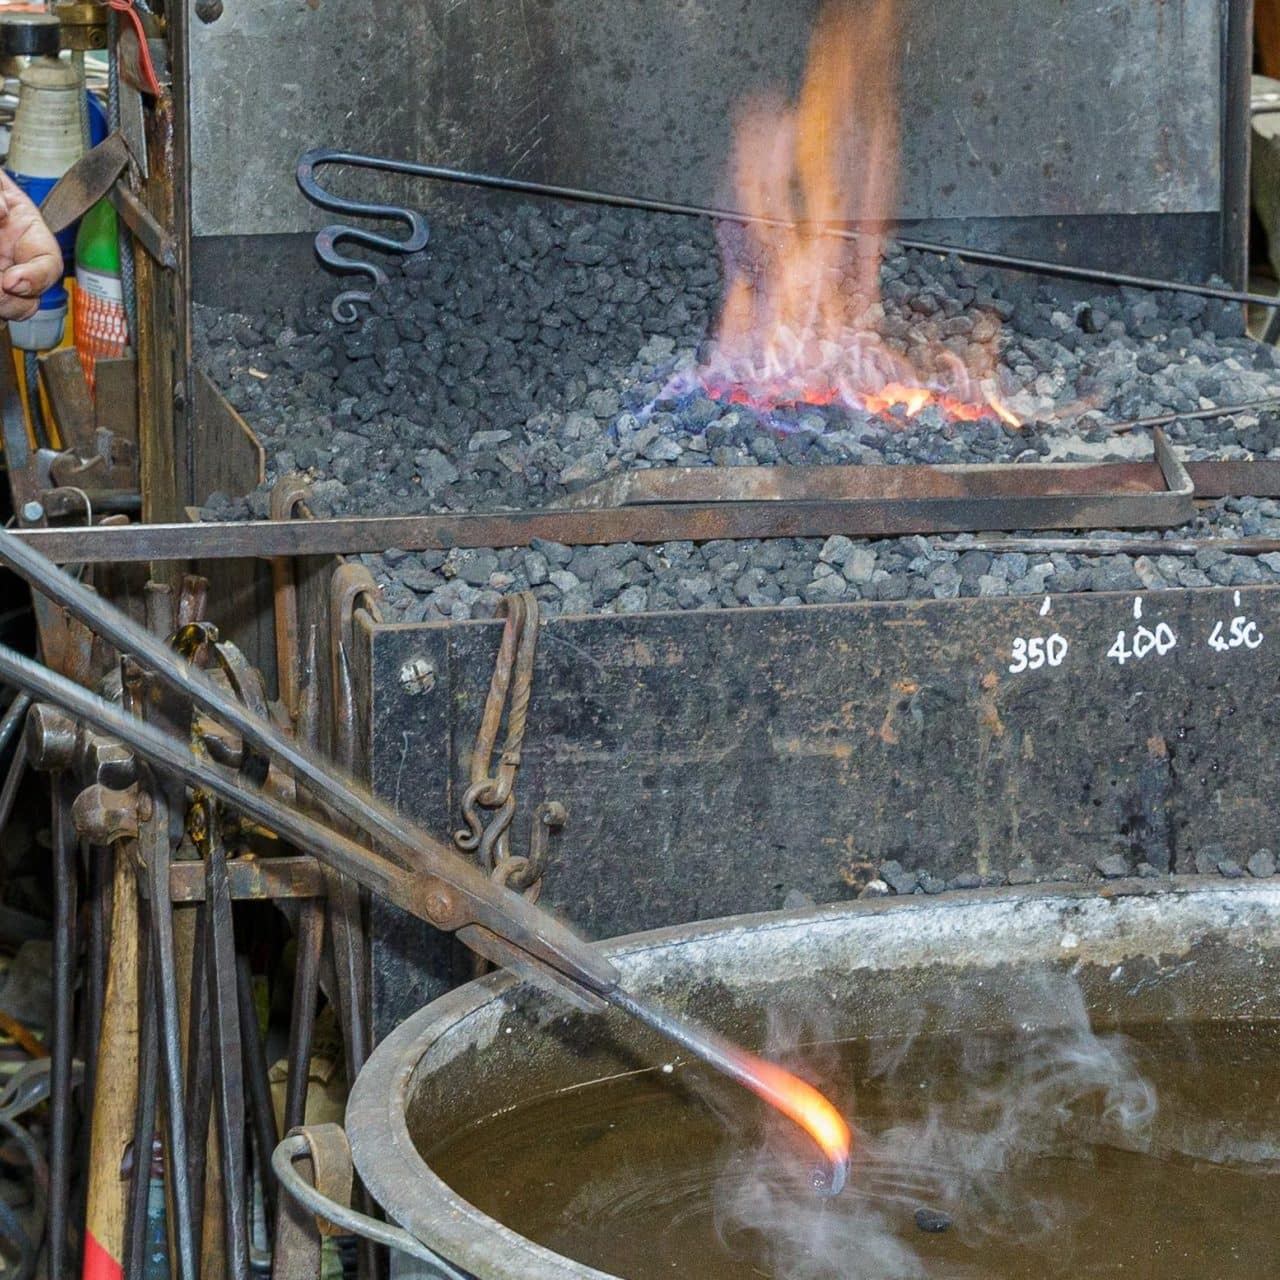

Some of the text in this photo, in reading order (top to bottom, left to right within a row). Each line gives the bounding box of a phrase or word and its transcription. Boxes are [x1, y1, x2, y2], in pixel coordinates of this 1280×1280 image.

[1008, 615, 1265, 674] 350 400 450
